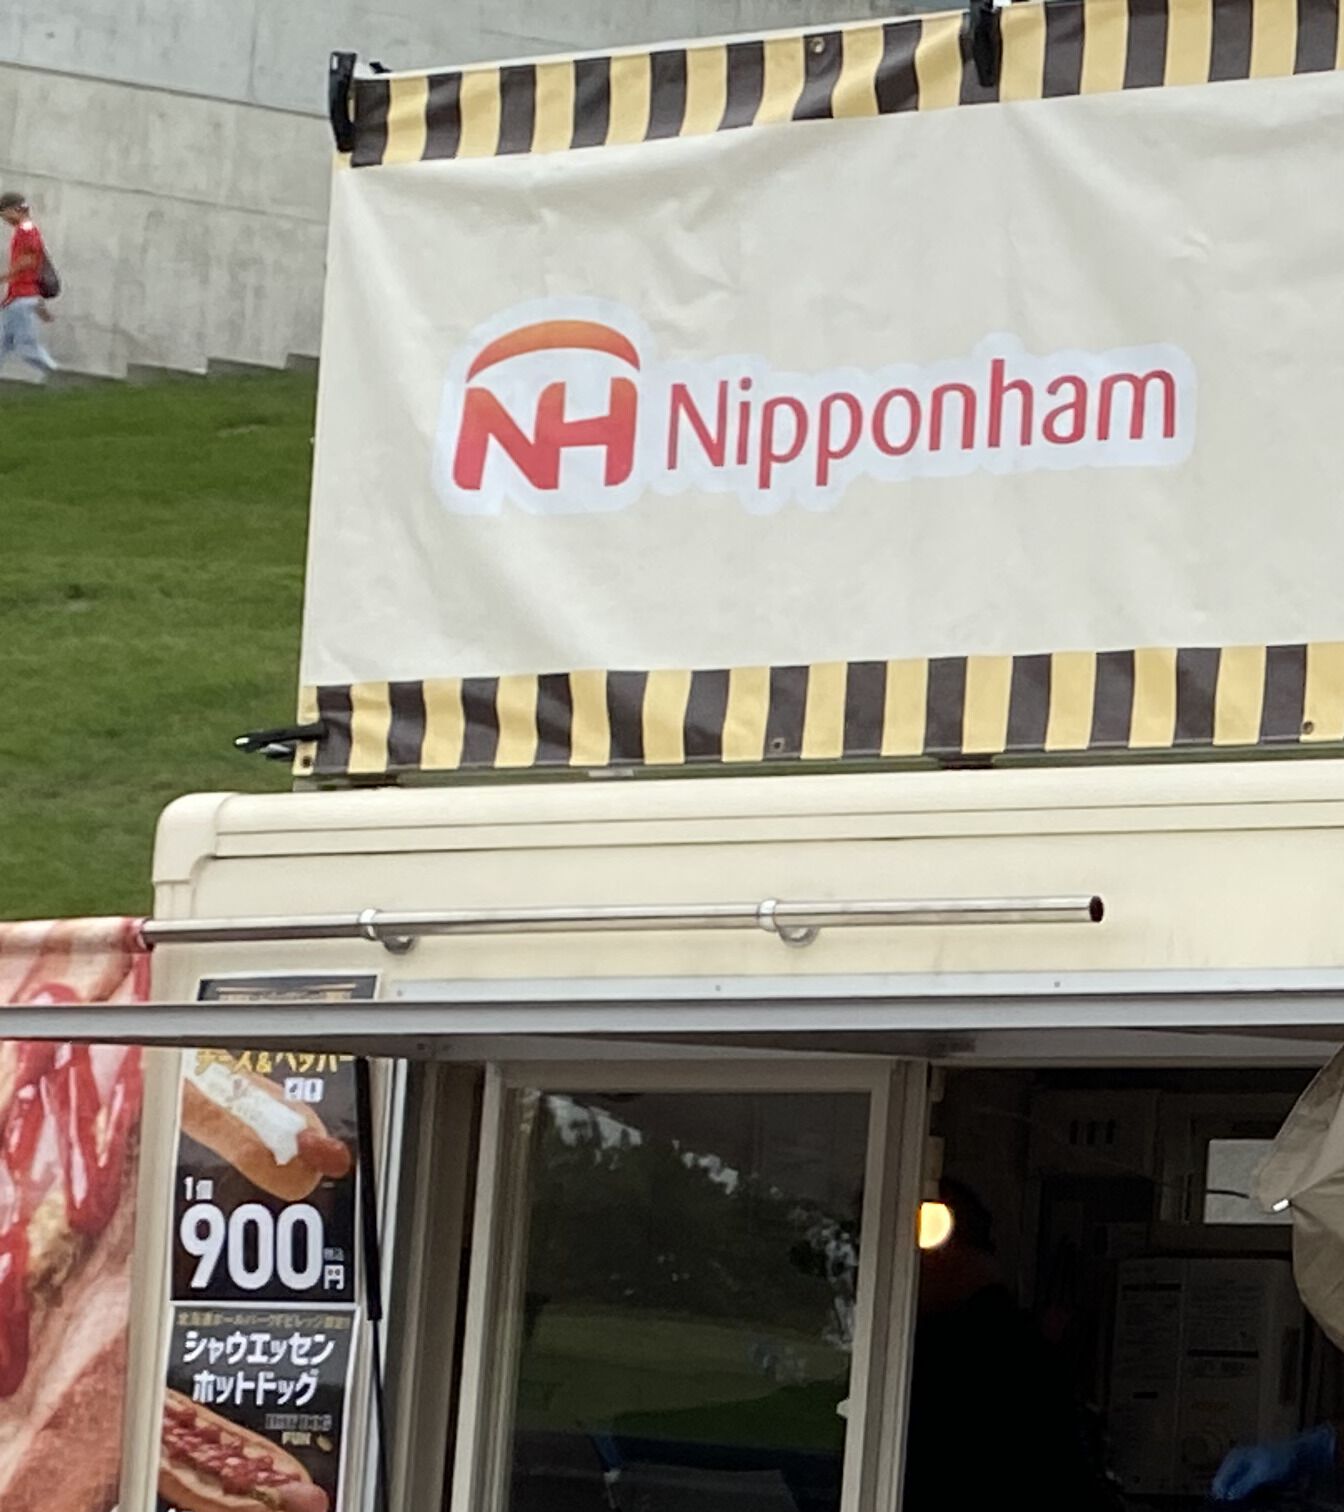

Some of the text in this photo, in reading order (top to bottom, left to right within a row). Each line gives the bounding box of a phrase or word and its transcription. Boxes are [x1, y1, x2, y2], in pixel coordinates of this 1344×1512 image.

[666, 357, 1178, 490] Nipponham
[182, 1331, 336, 1366] シャウエッセン
[192, 1369, 320, 1406] ホットドッグ
